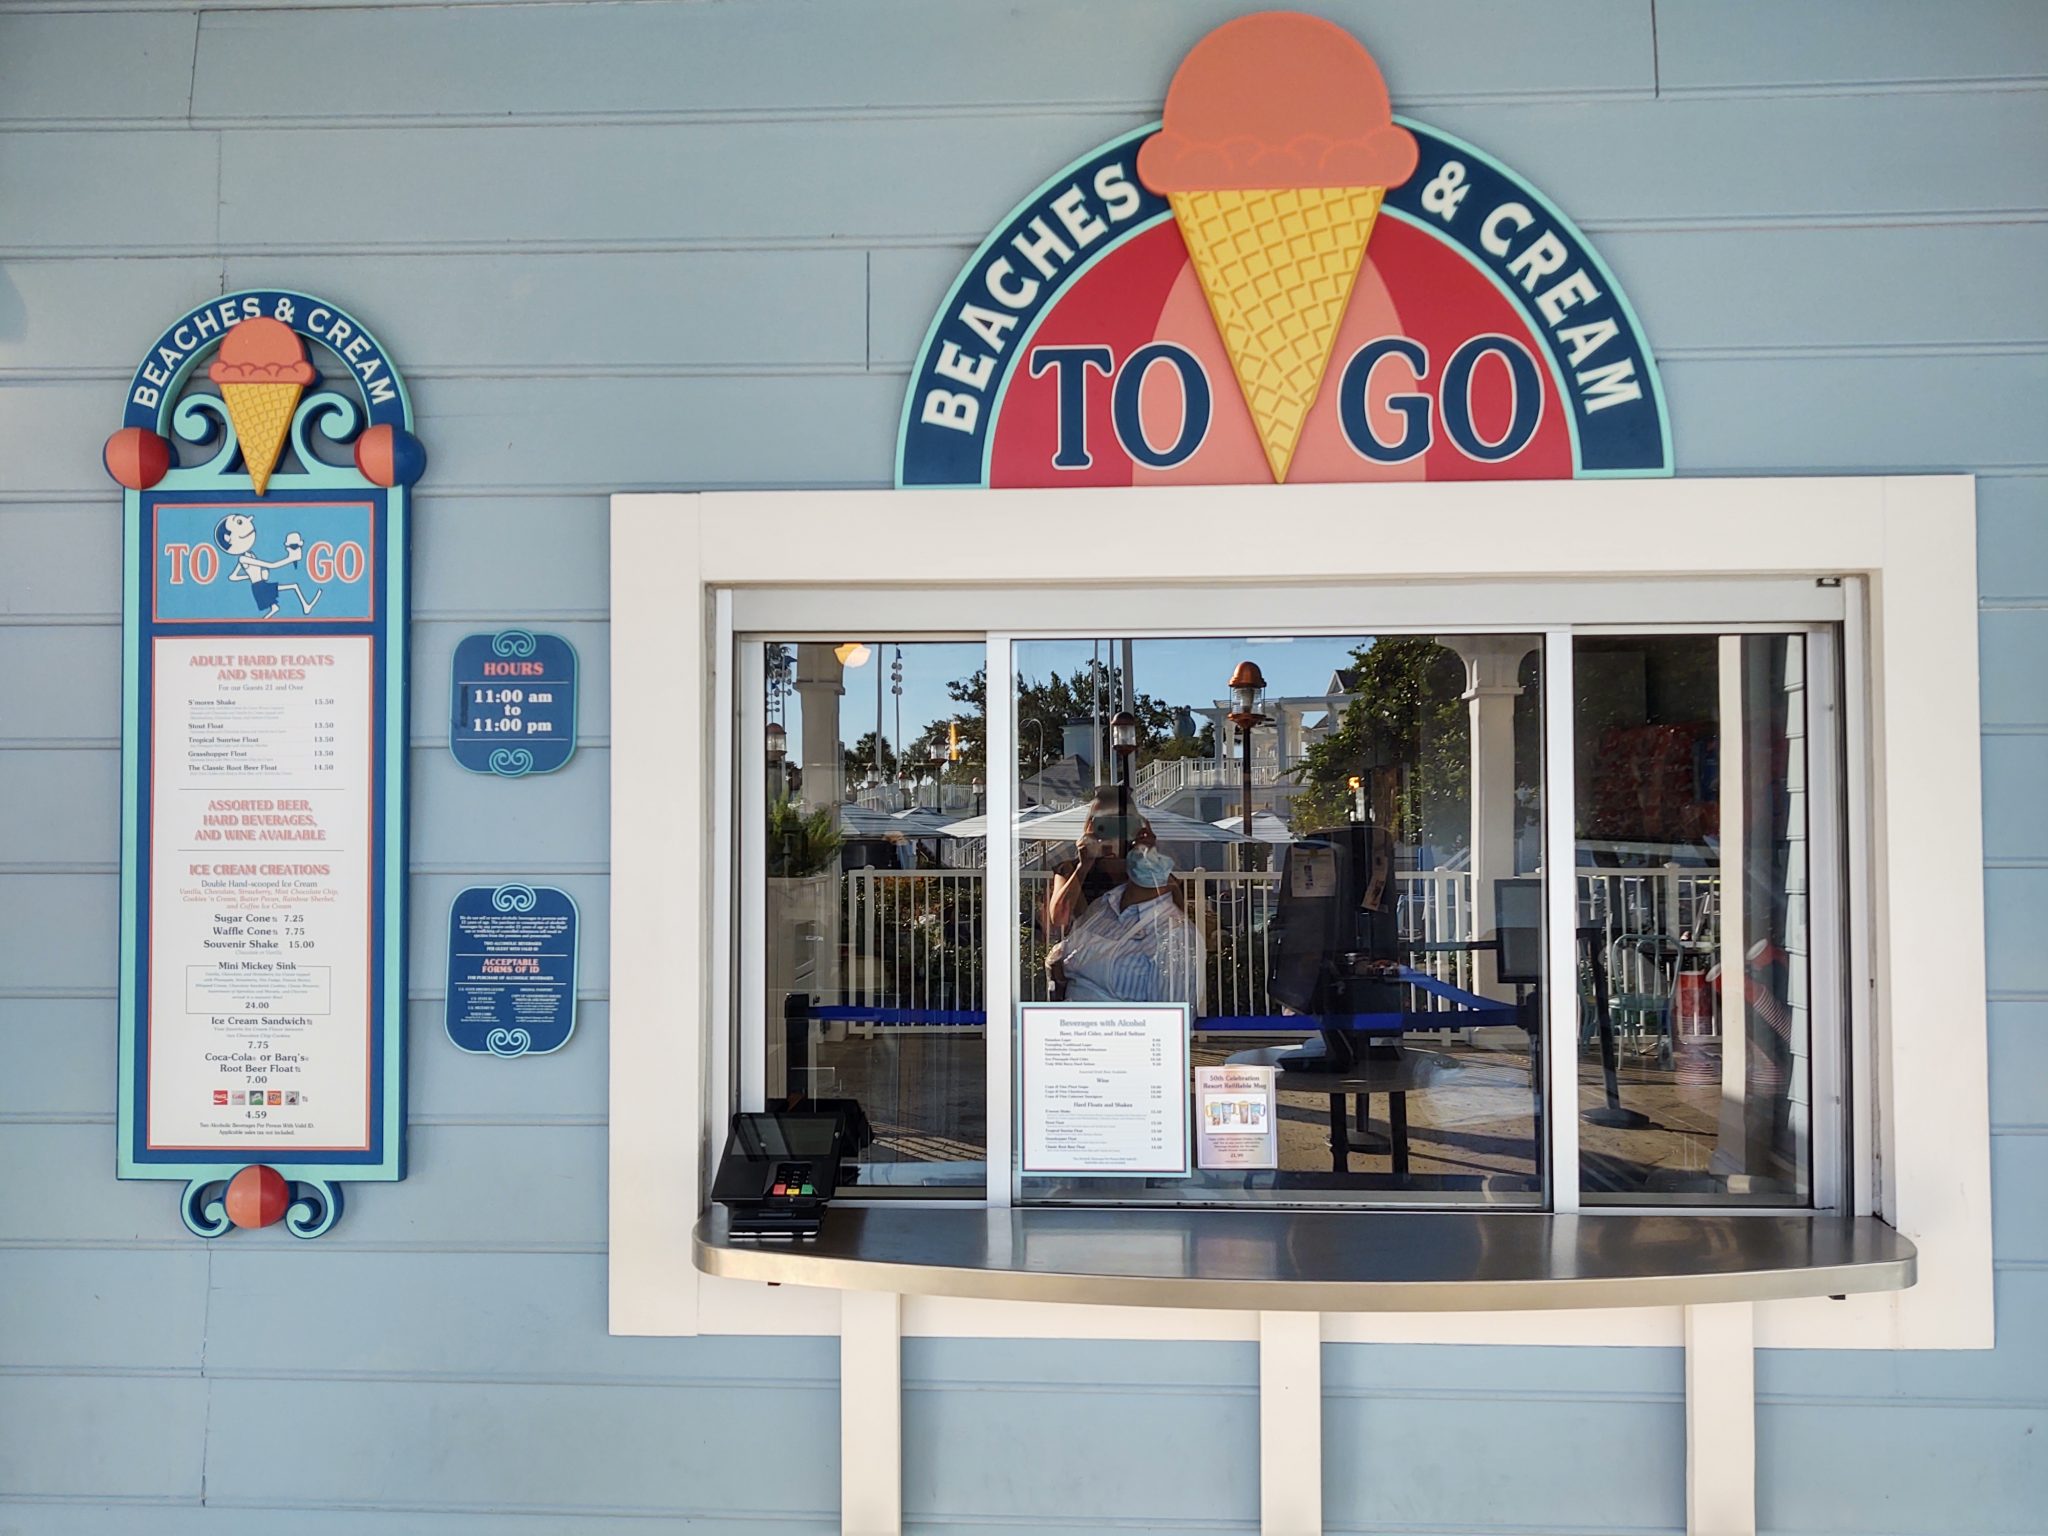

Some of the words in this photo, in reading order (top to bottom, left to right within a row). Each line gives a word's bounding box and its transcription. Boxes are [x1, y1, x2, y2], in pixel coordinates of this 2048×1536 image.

[921, 161, 1143, 436] BEACHES
[1420, 160, 1471, 222] &
[1479, 201, 1642, 415] CREAM
[133, 297, 261, 410] BEACHES
[274, 297, 295, 323] &
[308, 308, 395, 405] CREAM
[1030, 341, 1213, 472] TO
[1336, 333, 1545, 466] GO
[165, 542, 219, 585] TO
[306, 540, 365, 584] GO
[189, 655, 236, 667] ADULT
[238, 655, 277, 666] HARD
[281, 654, 334, 666] FLOATS
[484, 662, 544, 676] HOURS
[217, 669, 247, 680] AND
[251, 669, 306, 680] SHAKES
[475, 690, 523, 703] 11:00
[528, 692, 552, 702] am
[504, 704, 521, 716] to
[474, 718, 522, 732] 11:00
[527, 722, 552, 734] pm
[208, 800, 274, 811] ASSORTED
[277, 800, 313, 812] BEER,
[203, 815, 239, 826] HARD
[242, 815, 317, 827] BEVERAGES,
[195, 830, 221, 840] AND
[224, 830, 256, 840] WINE
[259, 829, 326, 840] AVAILABLE
[189, 864, 211, 876] ICE
[213, 864, 257, 876] CREAM
[260, 864, 331, 876] CREATIONS
[201, 880, 227, 888] Double
[229, 880, 280, 889] Hand-scooped
[293, 880, 318, 888] Cream
[214, 914, 243, 924] Sugar
[246, 914, 271, 923] Cone
[284, 915, 304, 923] 7.25
[213, 927, 244, 936] Waffle
[247, 927, 271, 936] Cone
[285, 928, 305, 936] 7.75
[203, 940, 246, 949] Souvenir
[249, 940, 279, 949] Shake
[289, 941, 315, 949] 15.00
[218, 962, 239, 970] Mini
[241, 962, 274, 972] Mickey
[276, 962, 297, 970] Sink
[484, 958, 539, 966] ACCEPTABLE
[211, 1017, 225, 1025] Ice
[228, 1017, 258, 1025] Cream
[262, 1017, 306, 1025] Sandwich
[1060, 1019, 1098, 1028] Beverages
[1100, 1019, 1116, 1027] with
[1118, 1019, 1146, 1027] Alcohol
[248, 1041, 269, 1049] 7.75
[260, 1054, 272, 1062] or
[220, 1065, 242, 1073] Root
[245, 1065, 267, 1073] Beer
[270, 1065, 294, 1073] Float
[246, 1076, 268, 1084] 7.00
[1254, 1082, 1267, 1090] Mug
[245, 1111, 267, 1119] 4.59
